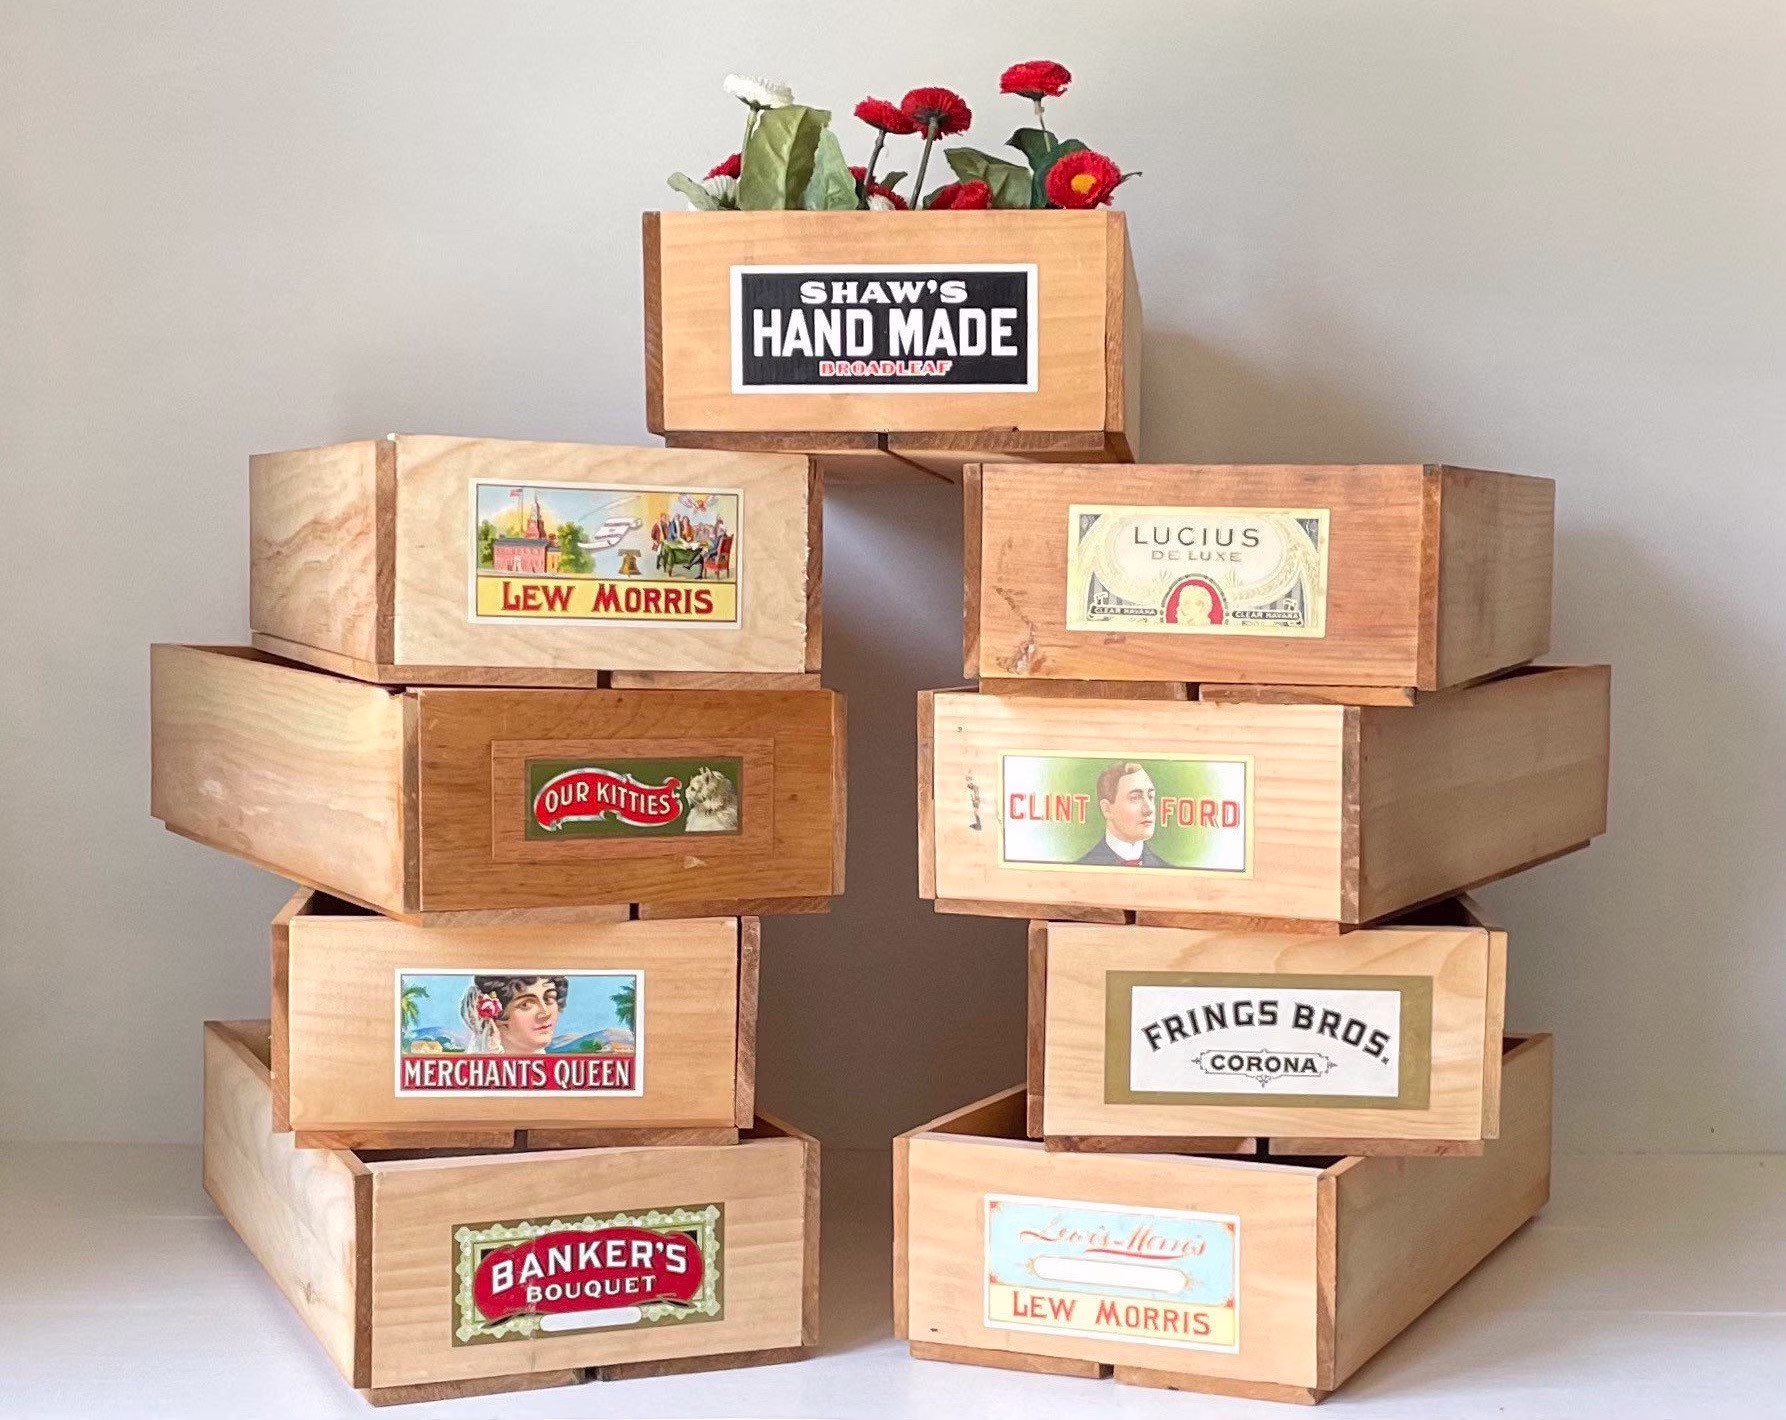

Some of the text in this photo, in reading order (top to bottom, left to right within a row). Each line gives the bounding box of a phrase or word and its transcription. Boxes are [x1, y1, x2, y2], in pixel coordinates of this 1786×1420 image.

[800, 280, 968, 304] SHAW'S
[753, 308, 1018, 357] HAND MADE
[819, 360, 953, 377] BROADLEAF
[1134, 526, 1260, 548] LUCIUS
[1151, 550, 1243, 562] DE LUXE
[501, 581, 714, 615] LEW MORRIS
[544, 781, 671, 815] OUR KITTIES
[1008, 793, 1241, 828] CLINT FORD
[1141, 1000, 1391, 1066] FRINGS BROS.
[404, 1059, 631, 1089] MERCHANTS QUEEN
[1210, 1054, 1318, 1073] CORONA
[491, 1239, 688, 1295] BANKER'S
[526, 1275, 657, 1303] BOUQUET
[1012, 1290, 1211, 1336] LEW MORRIS
